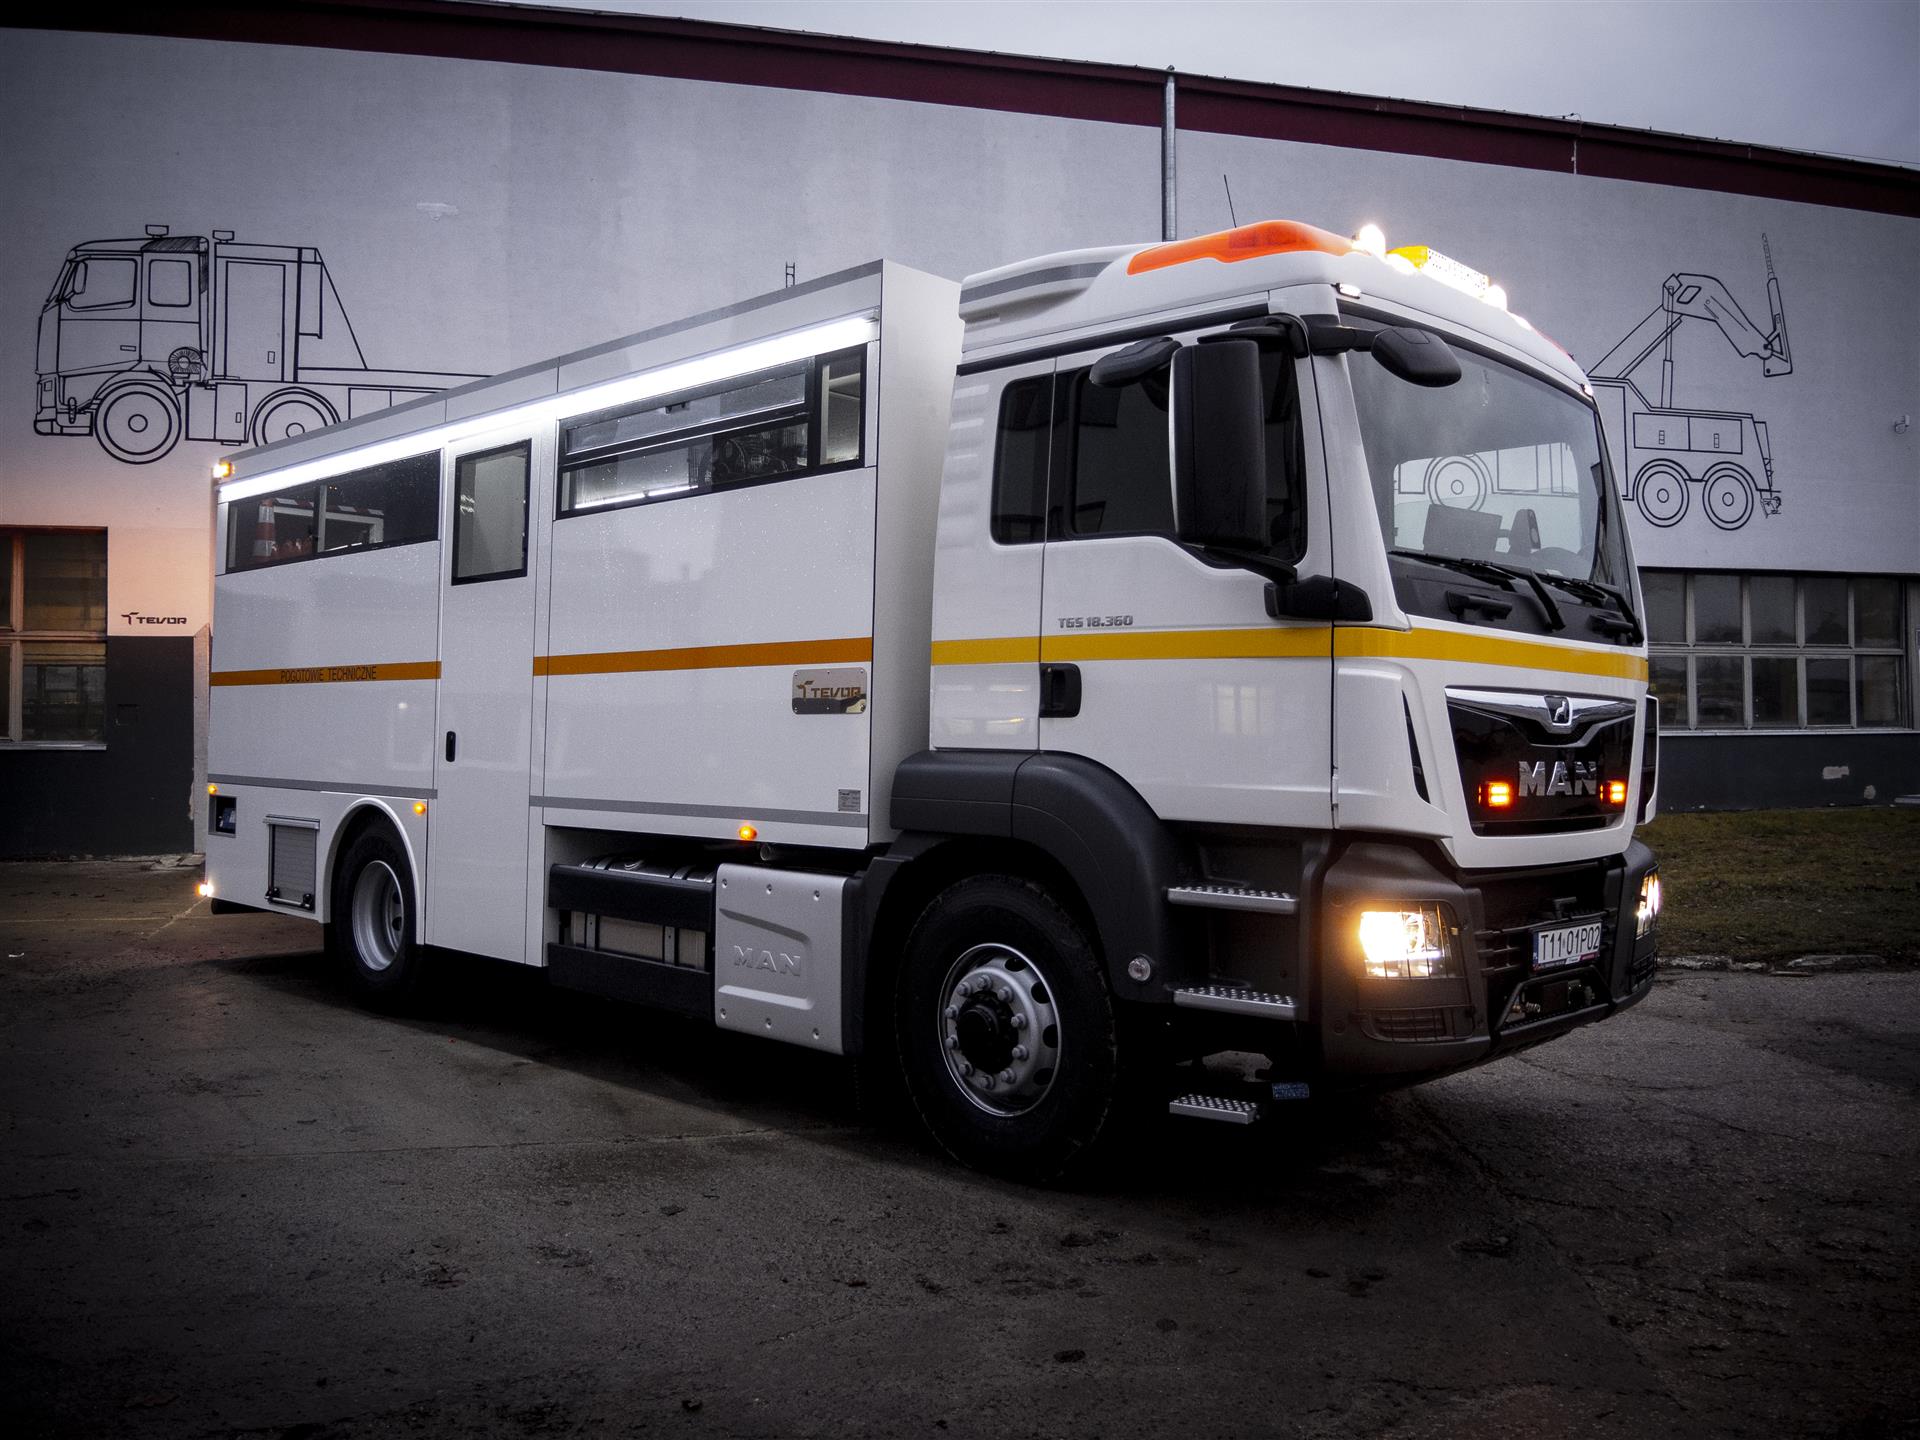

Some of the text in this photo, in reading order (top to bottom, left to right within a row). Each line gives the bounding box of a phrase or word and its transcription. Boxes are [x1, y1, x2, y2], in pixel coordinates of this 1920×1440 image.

[136, 617, 187, 625] TEVOR
[1058, 615, 1133, 628] TGS 18.360
[281, 666, 377, 682] POGOTOWIE TECHNICZNE
[811, 687, 861, 699] TEVOR
[1518, 761, 1597, 796] MAN
[733, 945, 801, 977] MAN
